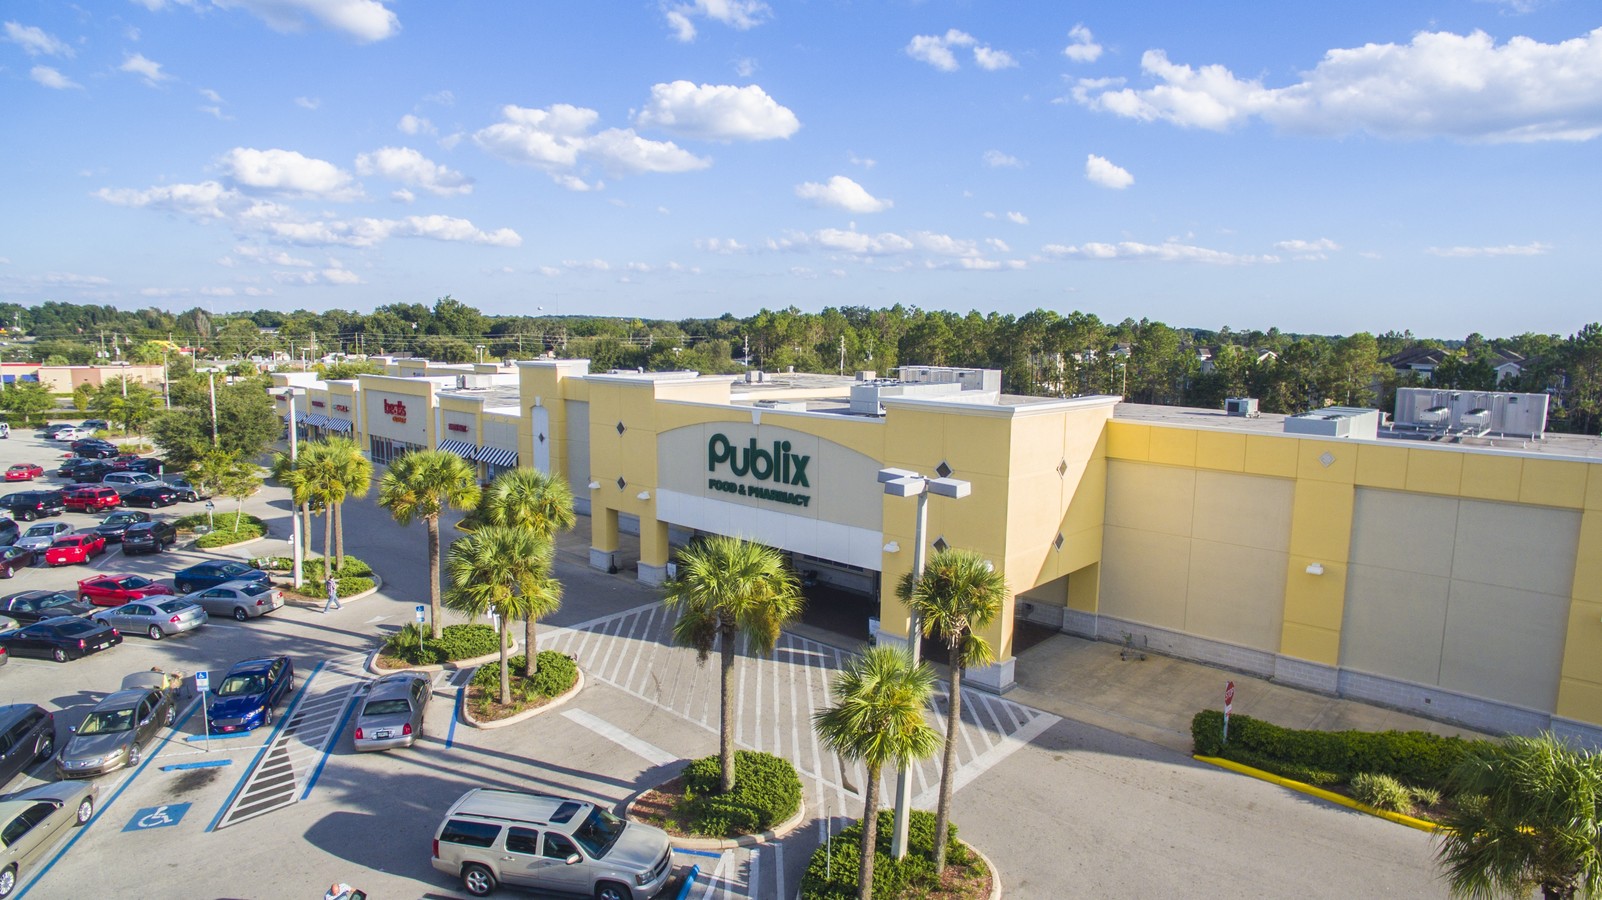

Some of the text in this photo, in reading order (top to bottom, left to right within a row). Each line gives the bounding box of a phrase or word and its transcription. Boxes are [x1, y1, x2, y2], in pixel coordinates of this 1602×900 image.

[708, 433, 811, 488] Publix
[709, 478, 811, 507] FOOD & PHARMACY
